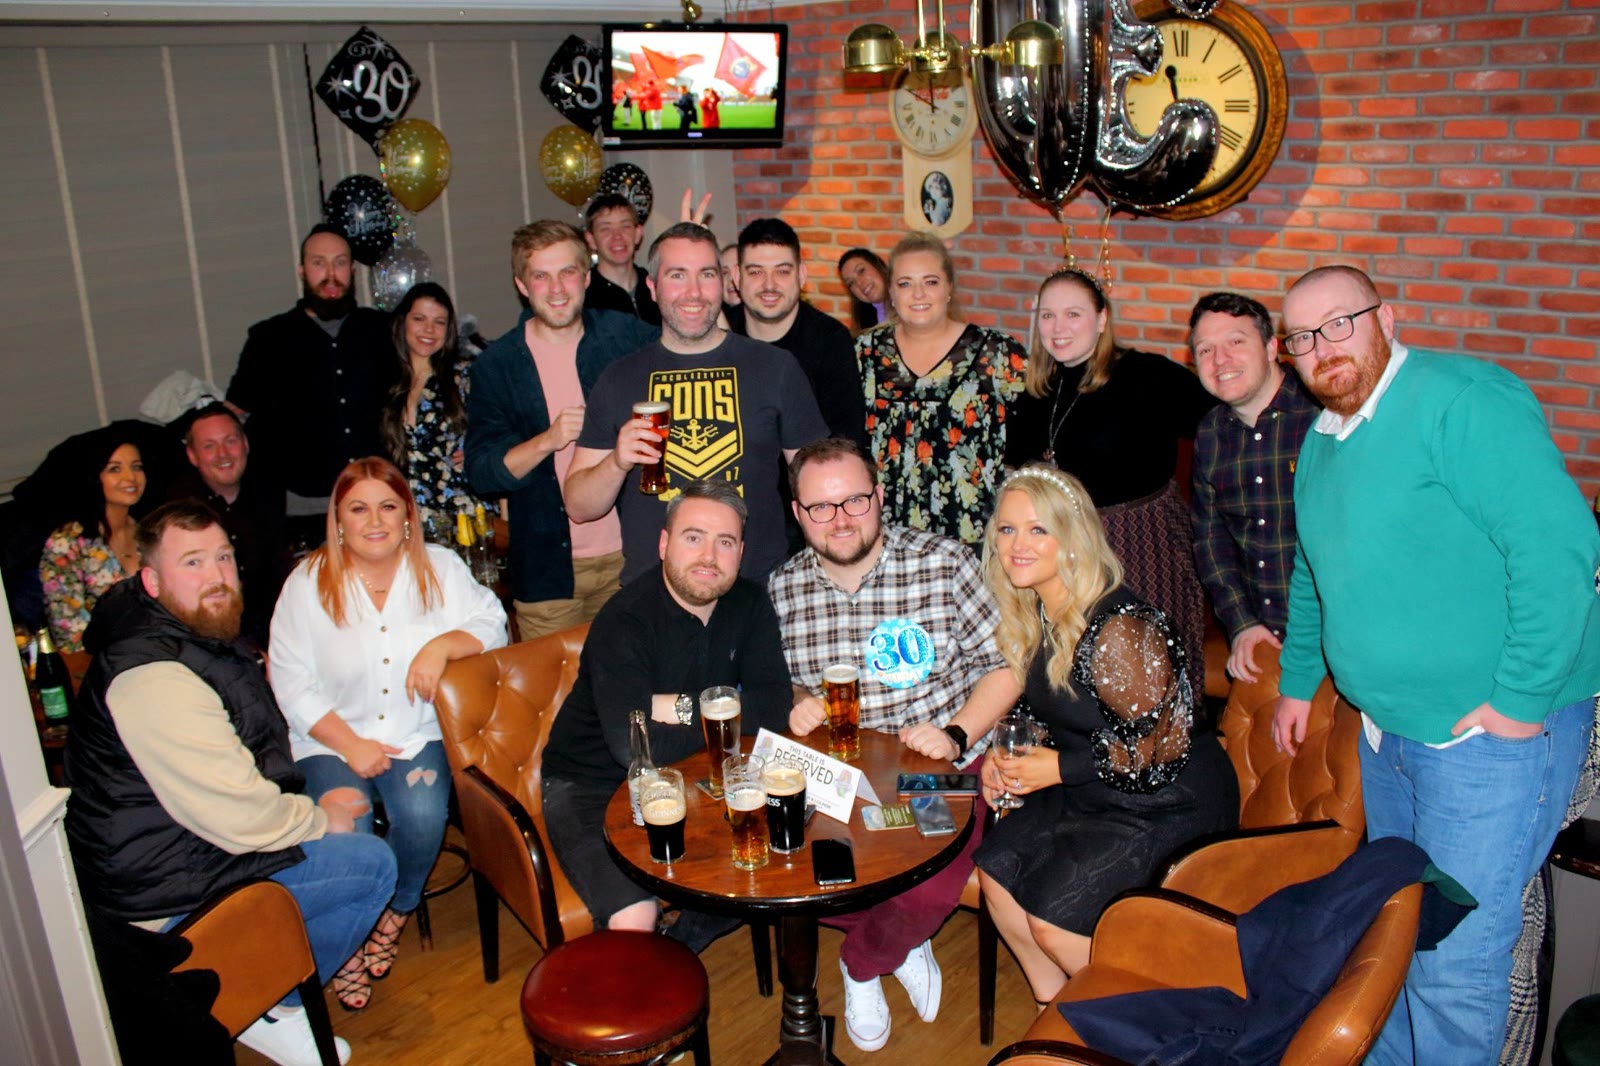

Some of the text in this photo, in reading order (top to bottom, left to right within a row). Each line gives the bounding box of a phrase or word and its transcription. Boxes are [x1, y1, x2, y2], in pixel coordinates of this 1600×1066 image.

[353, 60, 411, 123] 30
[870, 627, 929, 671] 30
[790, 745, 801, 755] THIS
[802, 750, 819, 763] TABLE
